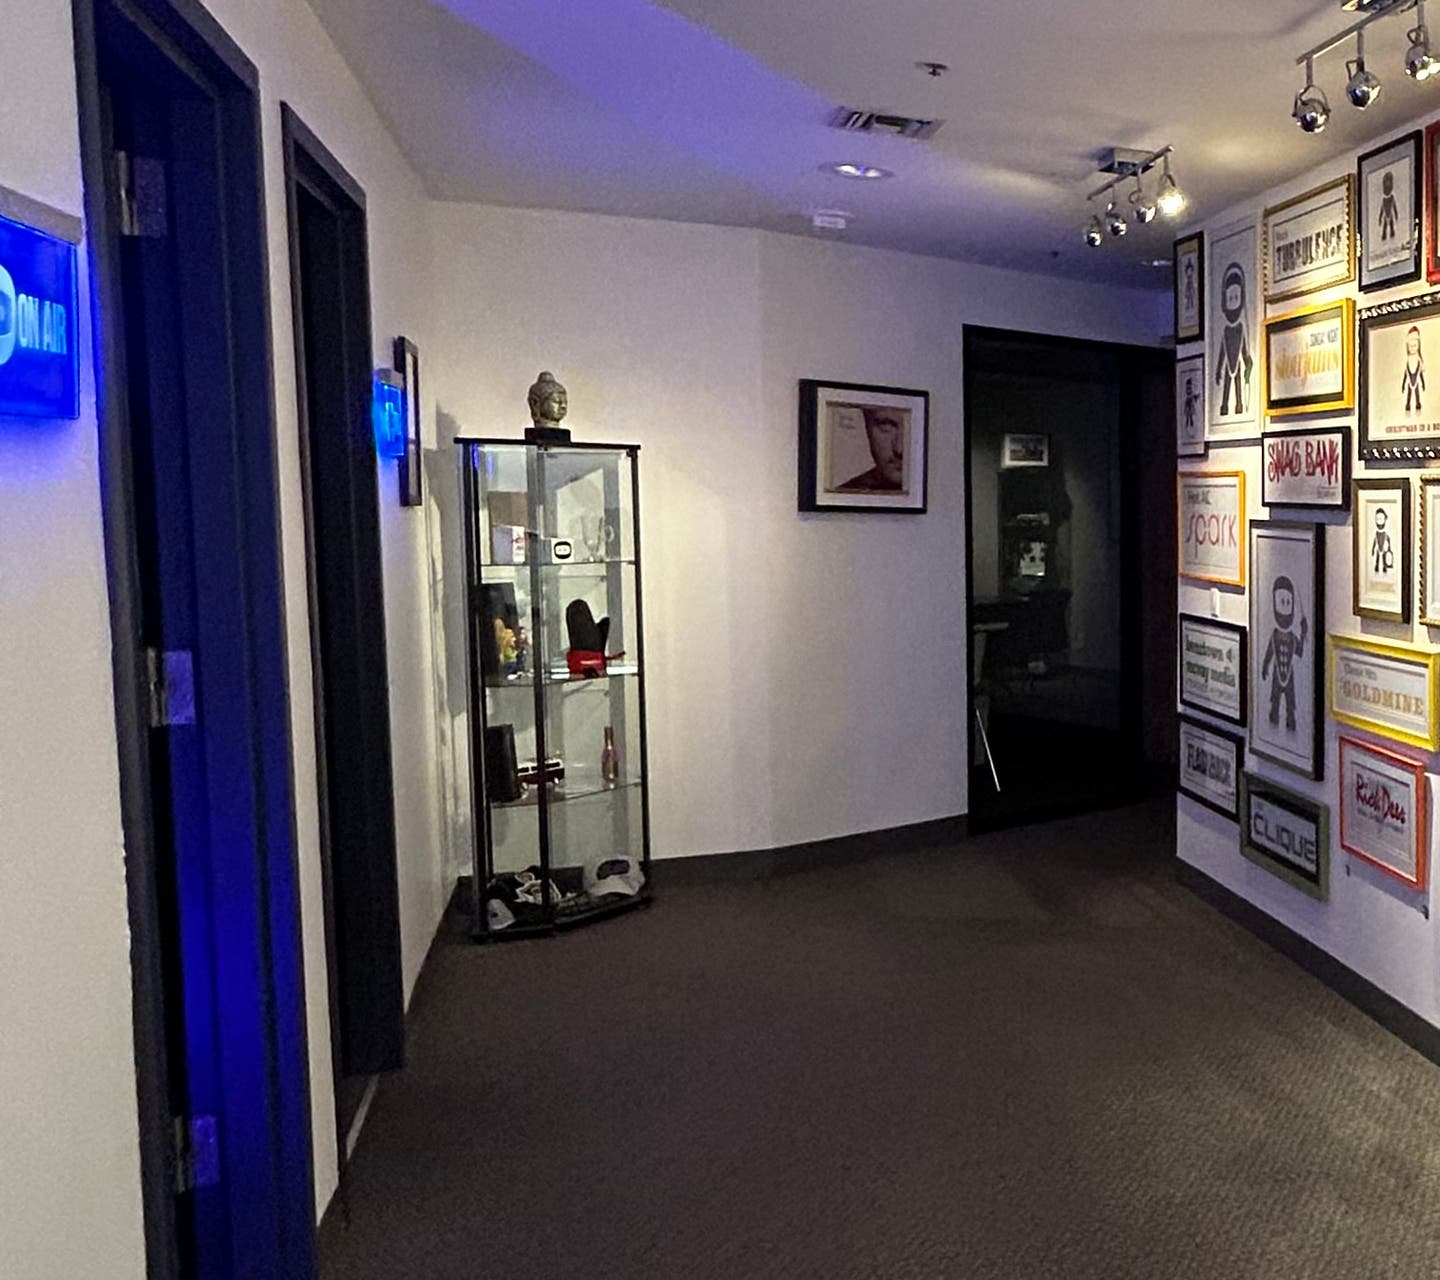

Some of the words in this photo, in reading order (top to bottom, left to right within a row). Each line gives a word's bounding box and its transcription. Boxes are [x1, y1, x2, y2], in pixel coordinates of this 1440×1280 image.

[1276, 224, 1343, 275] TURBULENCE
[18, 293, 39, 350] ON
[43, 301, 67, 355] AIR
[1268, 439, 1301, 483] SWAG
[1305, 438, 1339, 486] BANK
[1185, 513, 1237, 559] spark
[1343, 680, 1424, 715] GOLDMINE
[1253, 812, 1315, 865] CLIQUE
